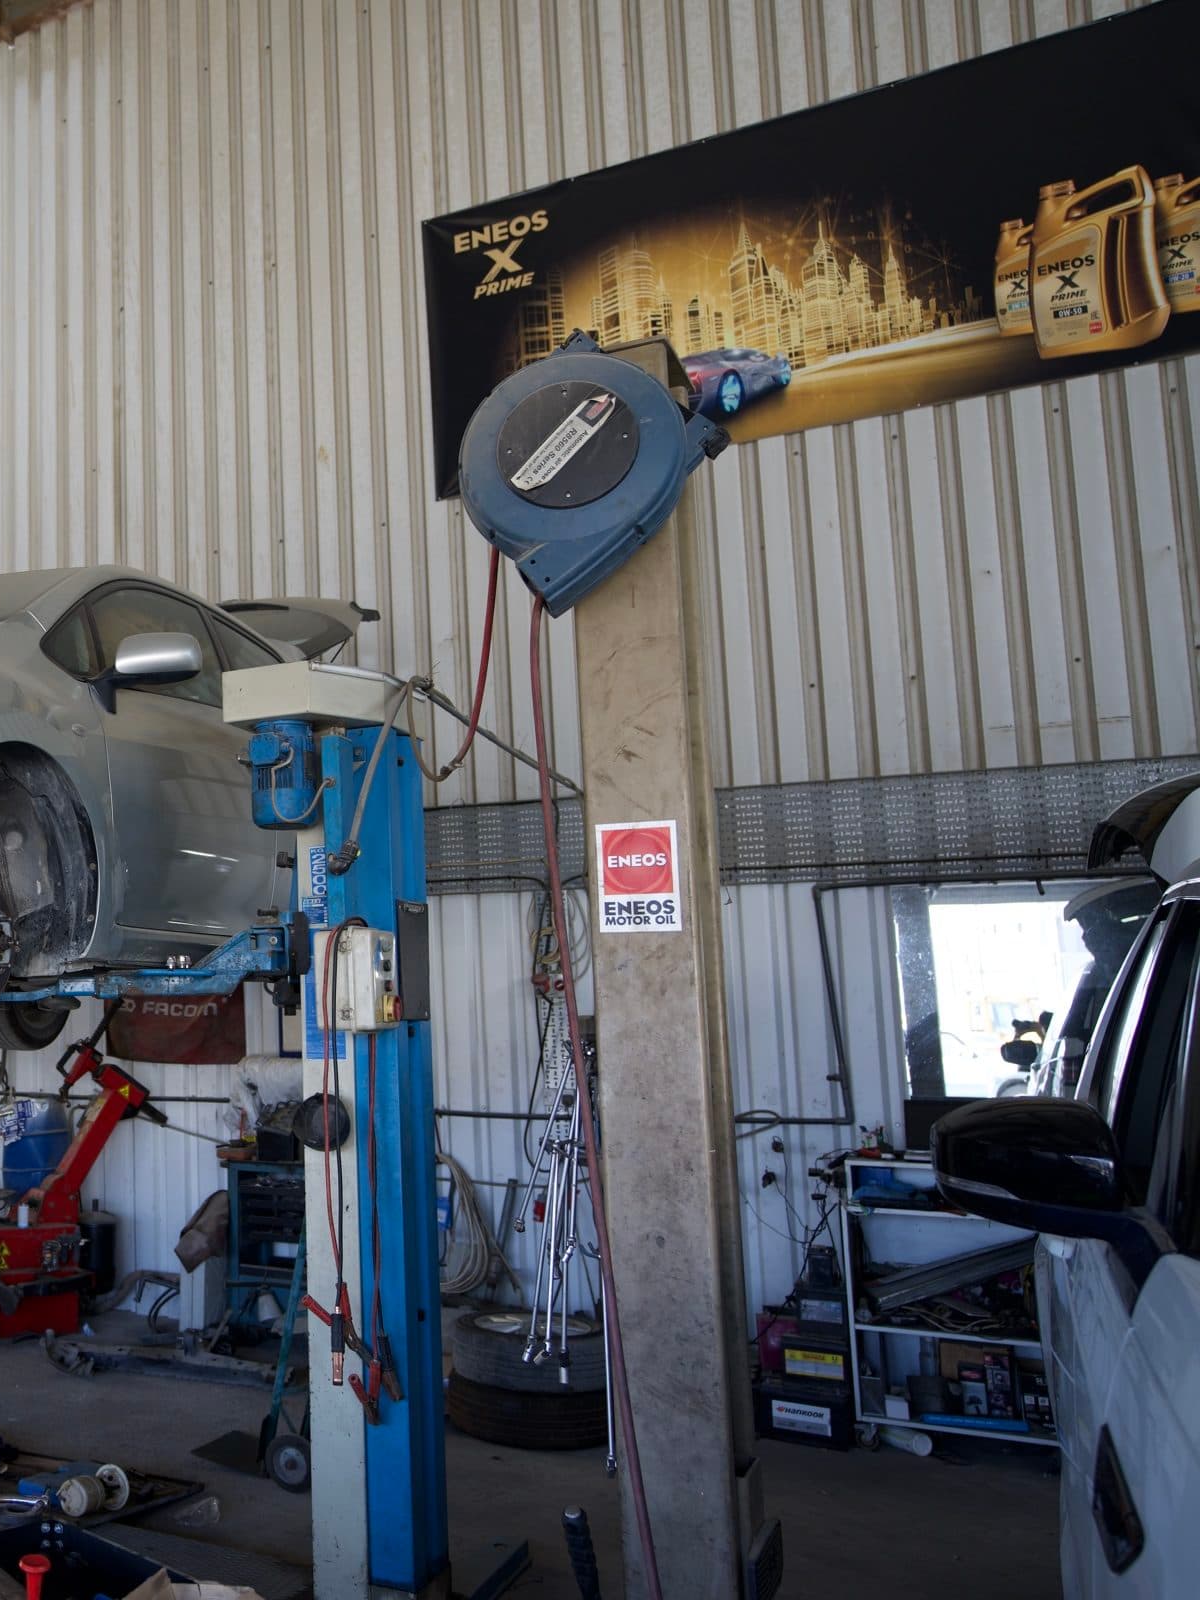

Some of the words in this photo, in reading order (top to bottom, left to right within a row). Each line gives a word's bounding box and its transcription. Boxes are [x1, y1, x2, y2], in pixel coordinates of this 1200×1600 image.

[454, 210, 549, 254] ENEOS
[1161, 232, 1200, 247] NEOS
[483, 239, 523, 283] X
[1167, 244, 1187, 262] X
[998, 270, 1029, 281] ENEO
[1037, 255, 1095, 276] ENEOS
[473, 271, 535, 300] PRIME
[1056, 270, 1079, 294] X
[1051, 289, 1088, 302] PRIME
[561, 430, 589, 458] Automatic
[533, 450, 556, 475] Series
[607, 853, 667, 868] ENEOS
[311, 853, 326, 896] 2500
[604, 900, 675, 916] ENEOS
[605, 915, 652, 926] MOTOR
[655, 915, 676, 925] OIL
